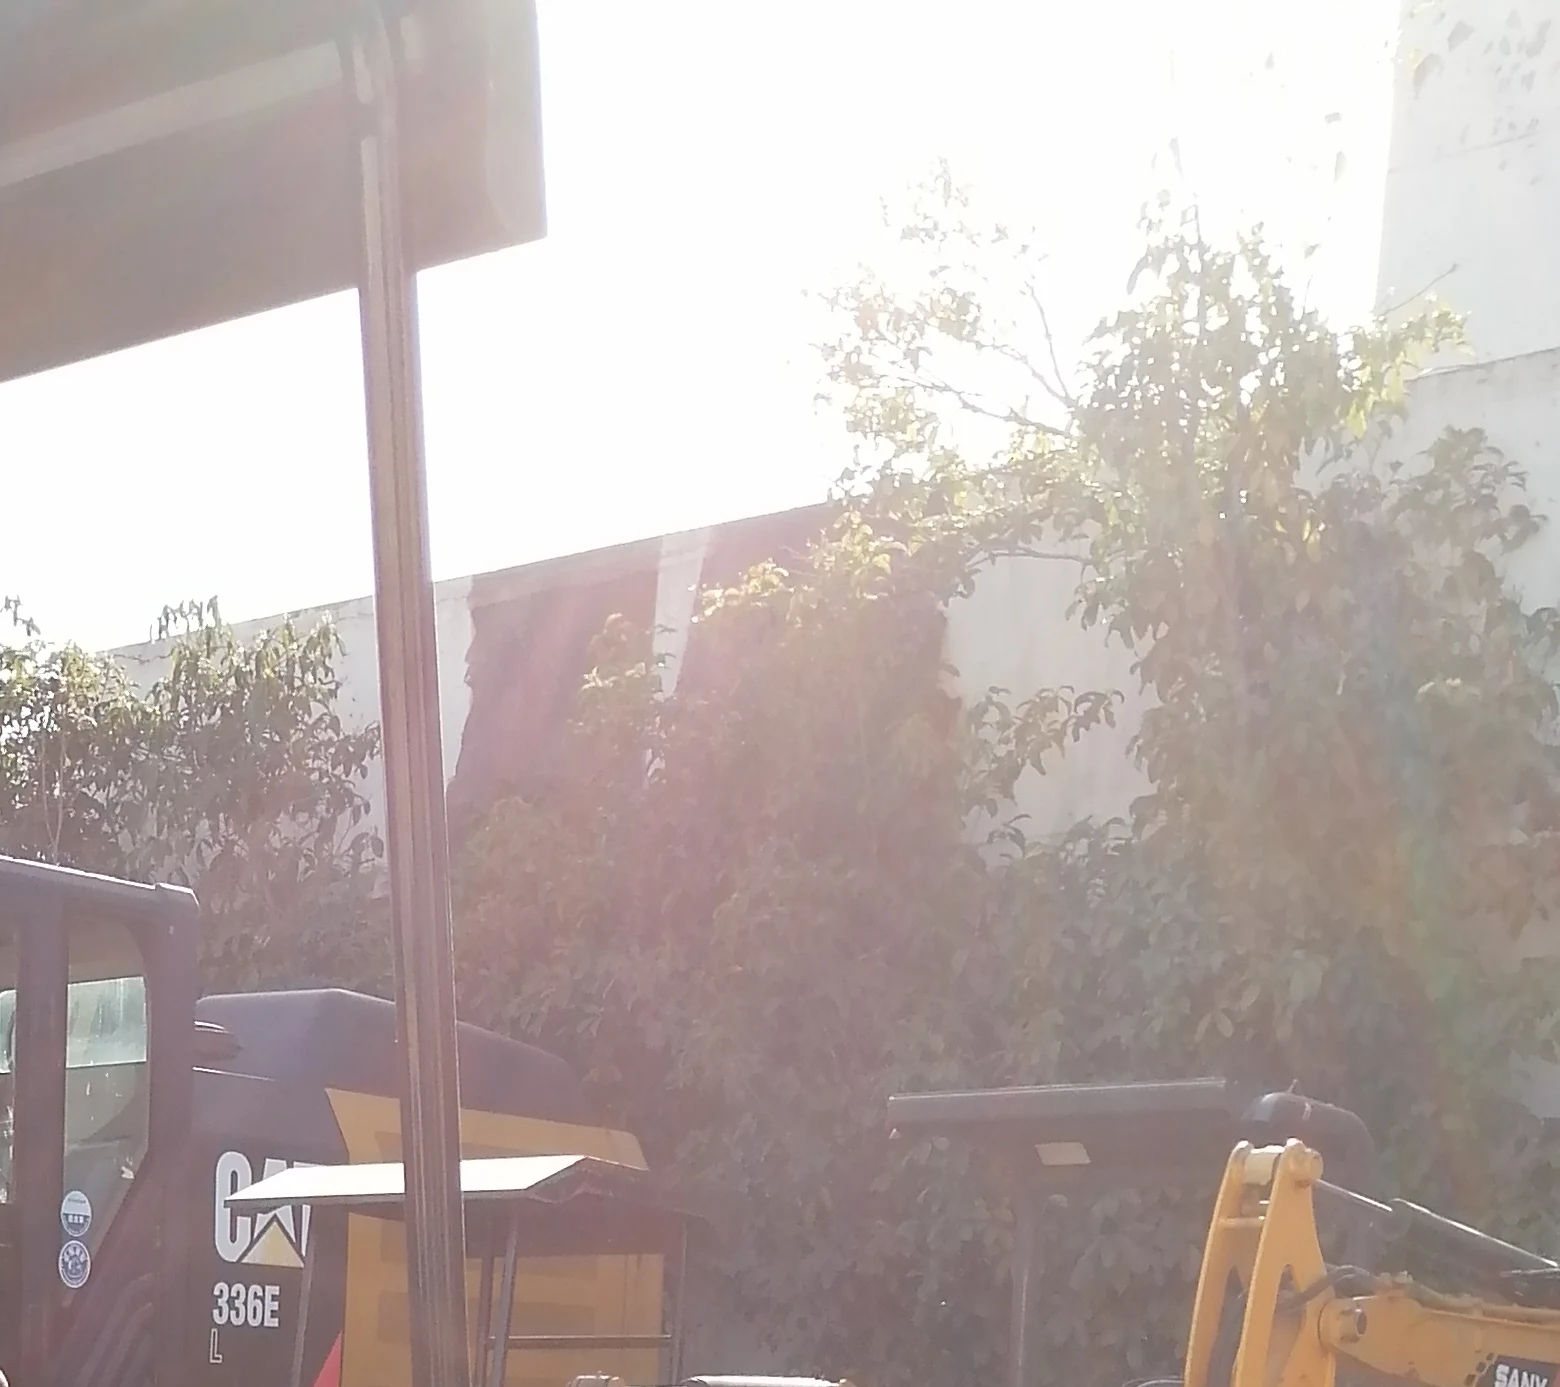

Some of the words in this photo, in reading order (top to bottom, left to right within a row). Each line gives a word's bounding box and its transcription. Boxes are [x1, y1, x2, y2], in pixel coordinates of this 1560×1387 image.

[215, 1150, 327, 1263] CA
[212, 1281, 280, 1328] 336E
[209, 1327, 223, 1364] L
